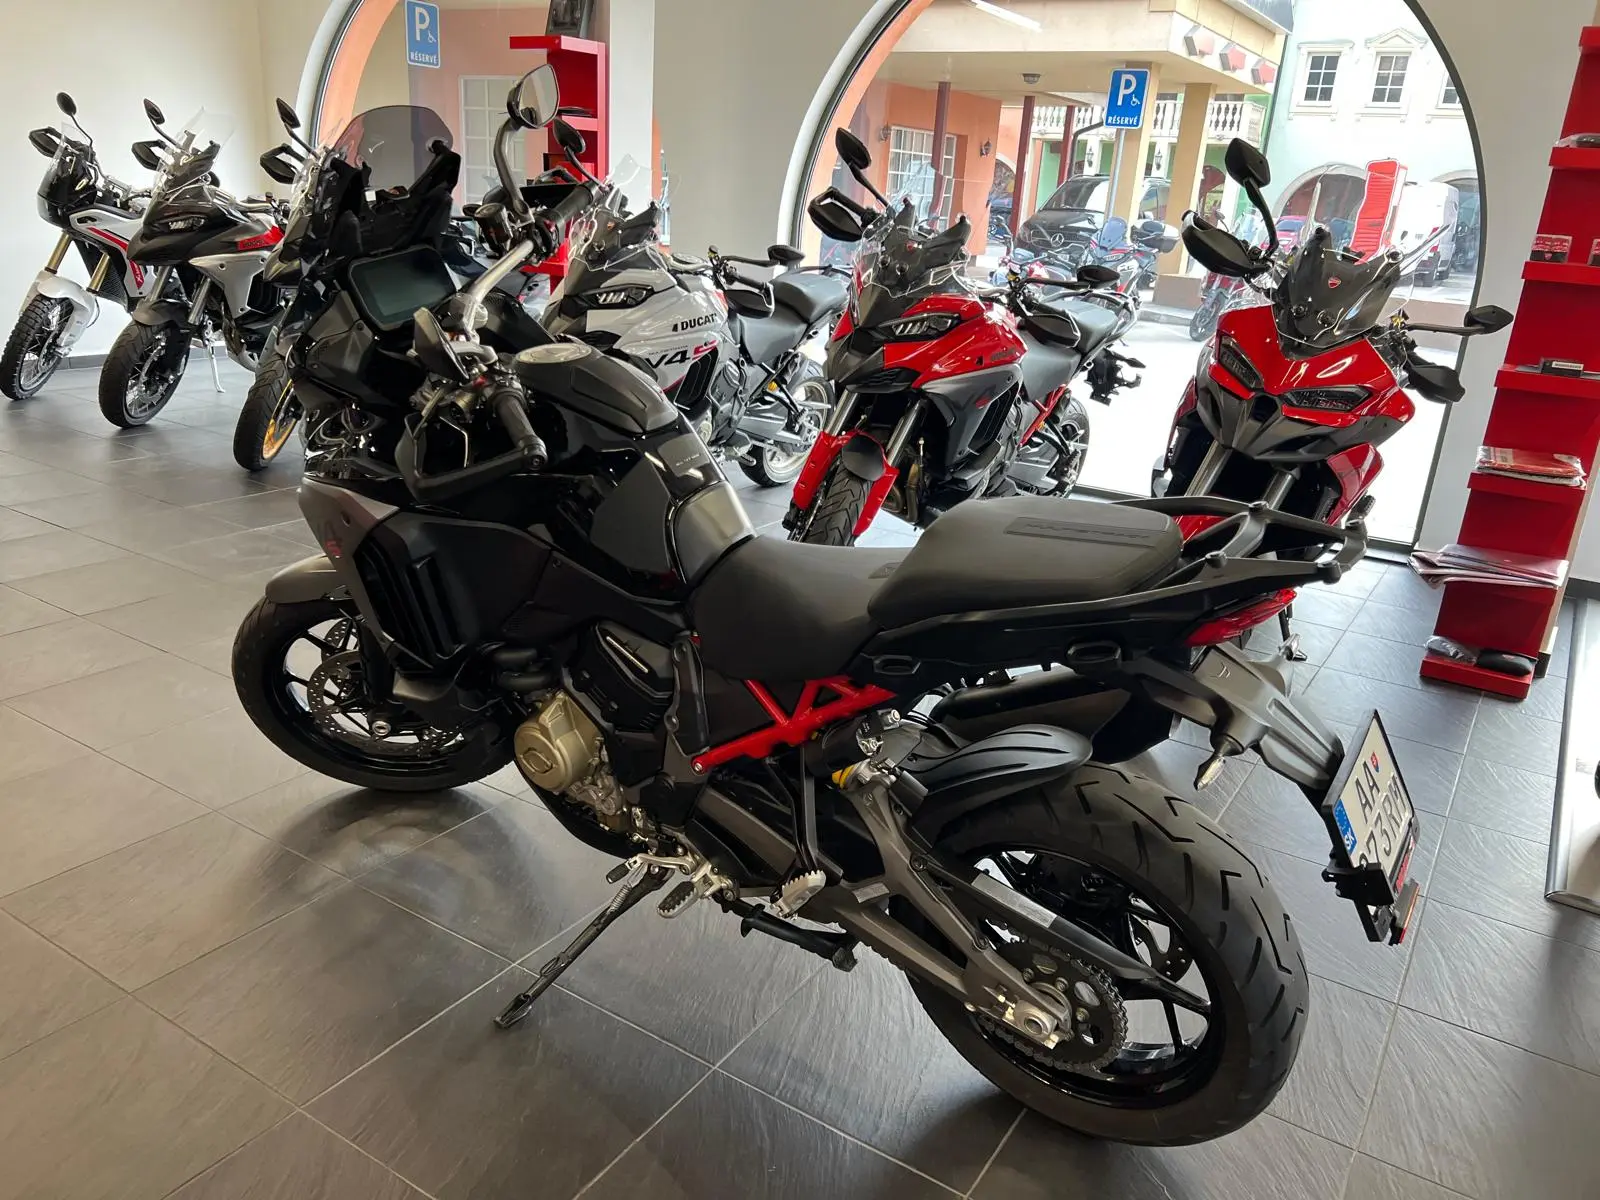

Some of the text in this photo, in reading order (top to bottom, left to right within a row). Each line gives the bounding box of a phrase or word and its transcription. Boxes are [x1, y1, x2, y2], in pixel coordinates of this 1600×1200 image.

[415, 6, 430, 41] P
[1117, 73, 1137, 106] P
[1107, 114, 1138, 126] RÉSERVÉ
[1355, 760, 1381, 825] AA
[1344, 827, 1355, 850] SK
